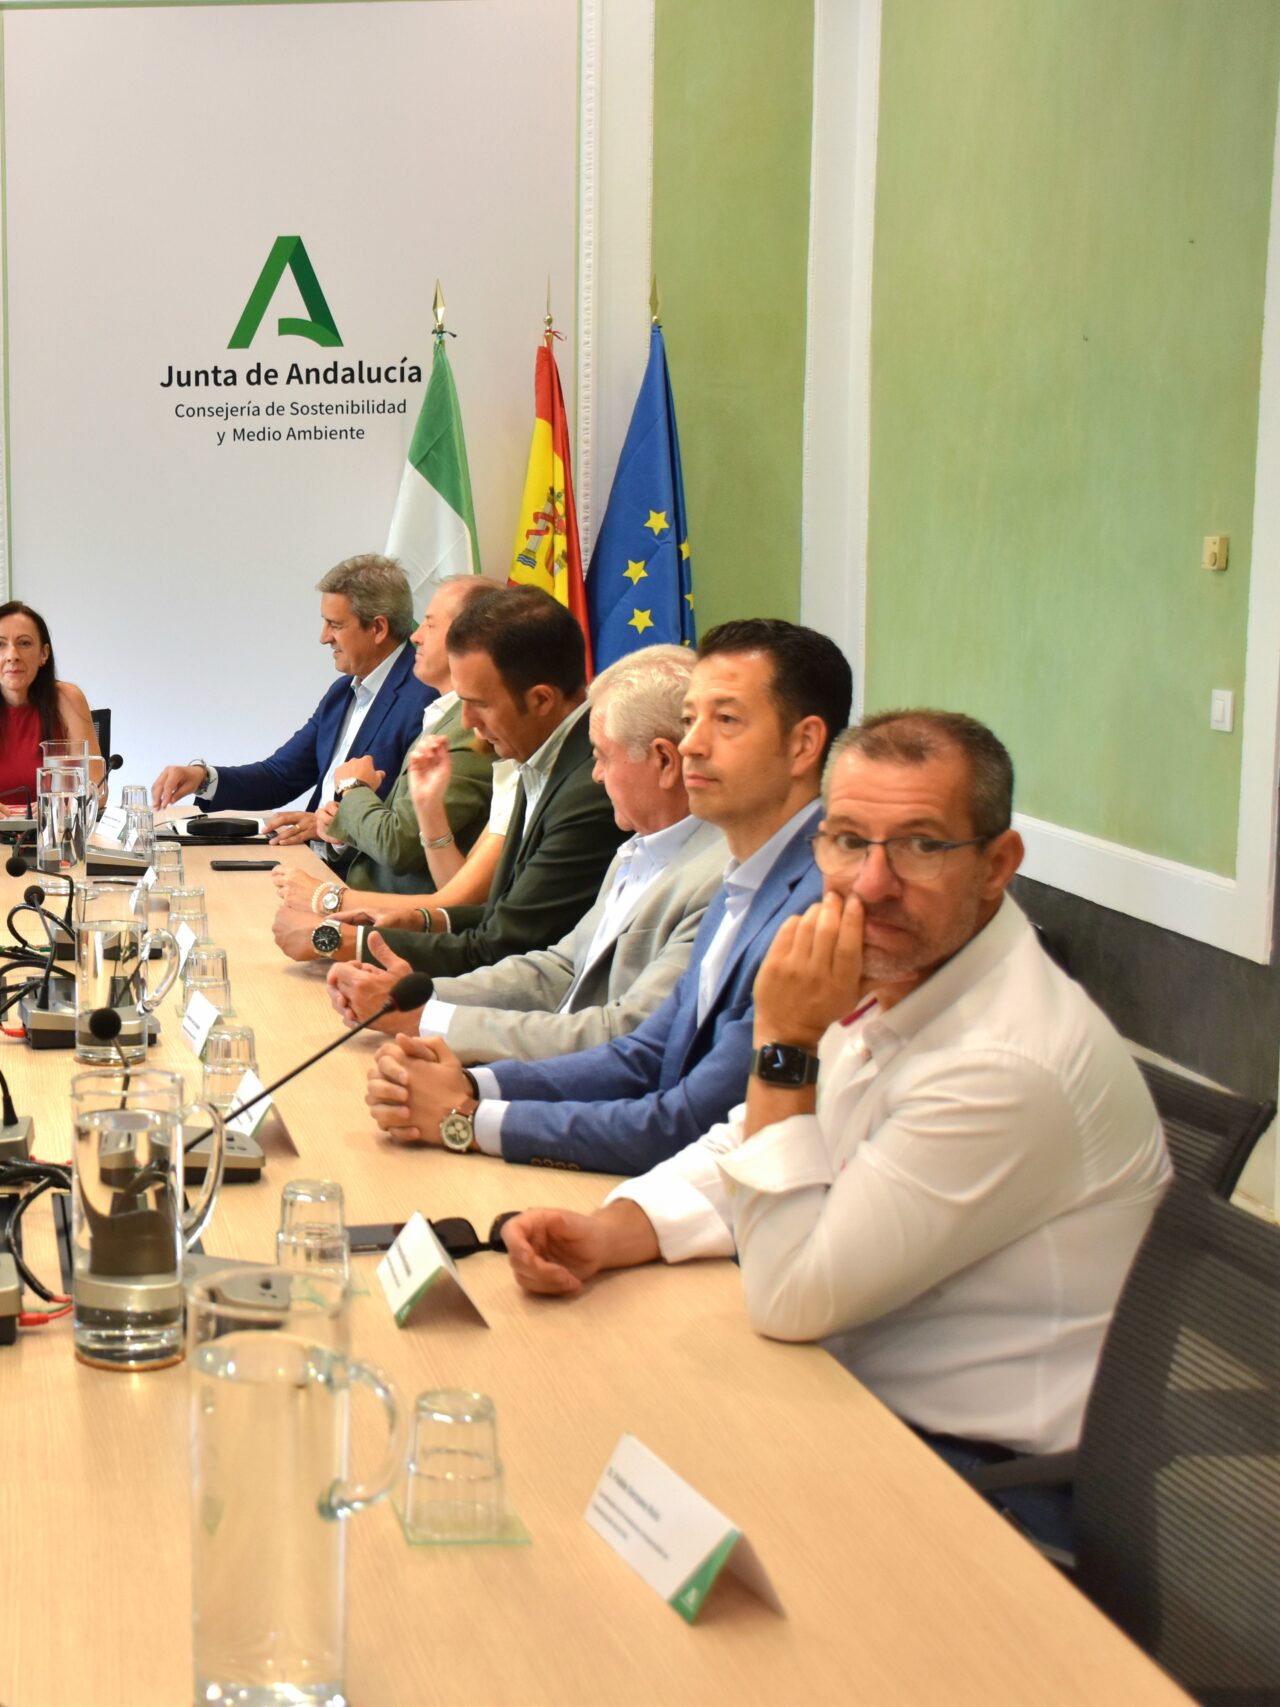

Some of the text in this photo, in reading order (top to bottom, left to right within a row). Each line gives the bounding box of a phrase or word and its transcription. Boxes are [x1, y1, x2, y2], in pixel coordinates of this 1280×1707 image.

[159, 356, 422, 388] Junta de Andalucía
[174, 398, 407, 421] Consejería de Sostenibilidad
[216, 425, 365, 446] y Medio Ambiente
